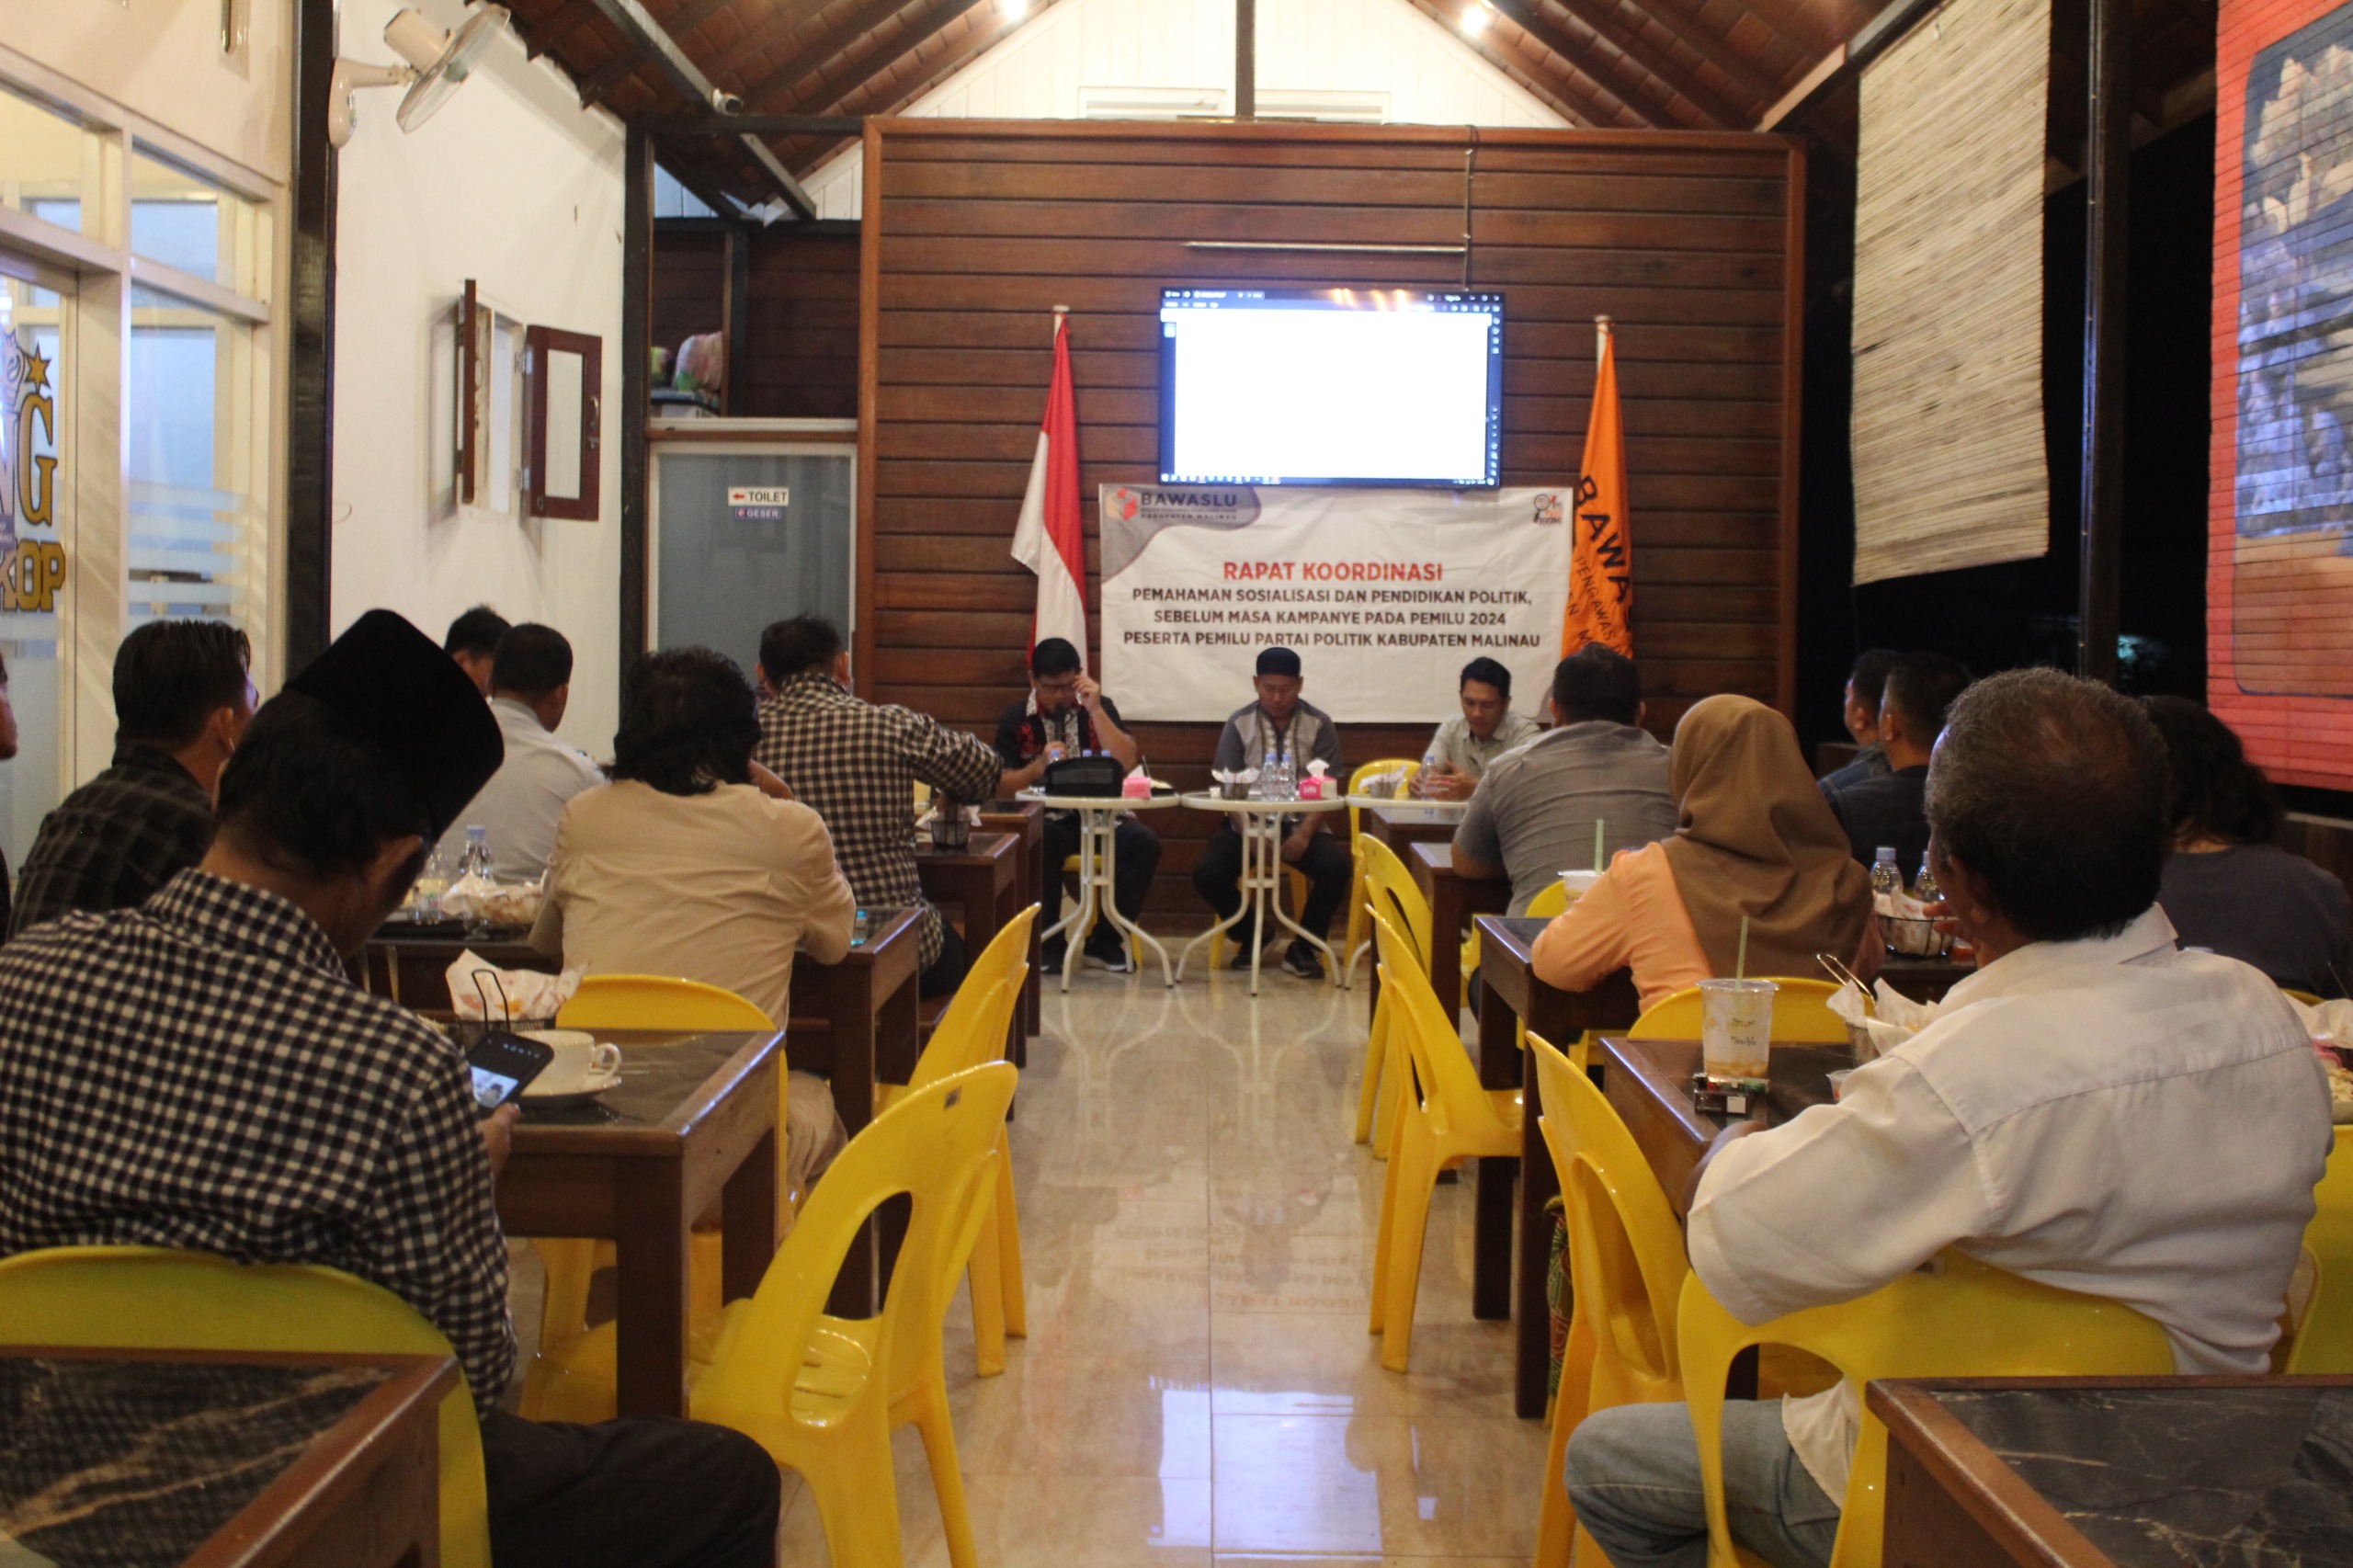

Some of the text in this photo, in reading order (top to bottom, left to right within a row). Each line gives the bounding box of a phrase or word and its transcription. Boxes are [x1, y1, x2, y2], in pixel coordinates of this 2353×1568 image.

[748, 492, 788, 503] TOILET
[1141, 493, 1238, 507] BAWASLU
[746, 508, 779, 519] GESER
[1223, 561, 1444, 583] RAPAT KOORDINASI
[1132, 587, 1532, 607] PEMAHAMAN SOSIALISASI DAN PENDIDIKAN POLITIK,
[1154, 609, 1506, 626] SEBELUM MASA KAMPANYE PADA PEMILU 2024
[1123, 631, 1540, 648] PESERTA PEMILU PARTAI POLITIK KABUPATEN MALINAU
